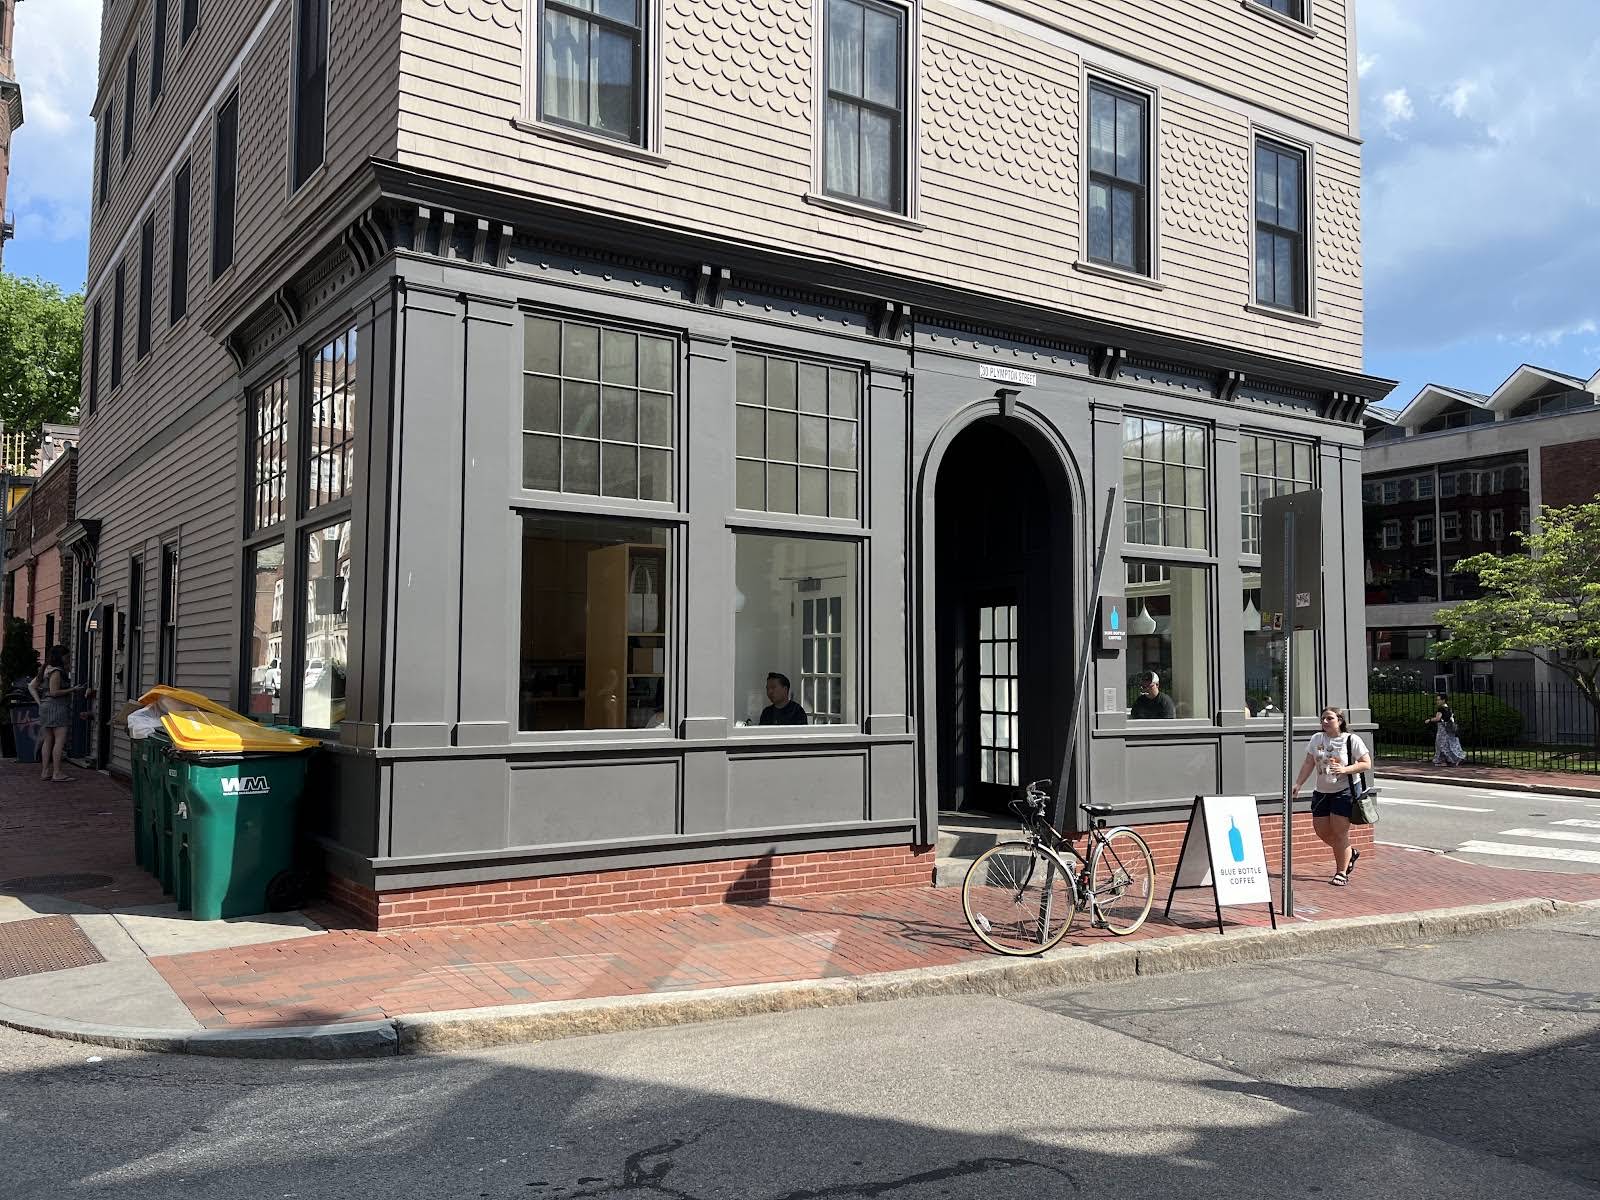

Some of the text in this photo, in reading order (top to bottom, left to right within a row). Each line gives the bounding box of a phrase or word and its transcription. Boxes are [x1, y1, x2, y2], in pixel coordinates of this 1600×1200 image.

[990, 366, 1018, 381] PLYMPTON
[1018, 371, 1036, 385] STREET
[220, 776, 271, 791] WM
[1238, 866, 1262, 875] BOTTLE
[1230, 876, 1255, 885] COFFEE
